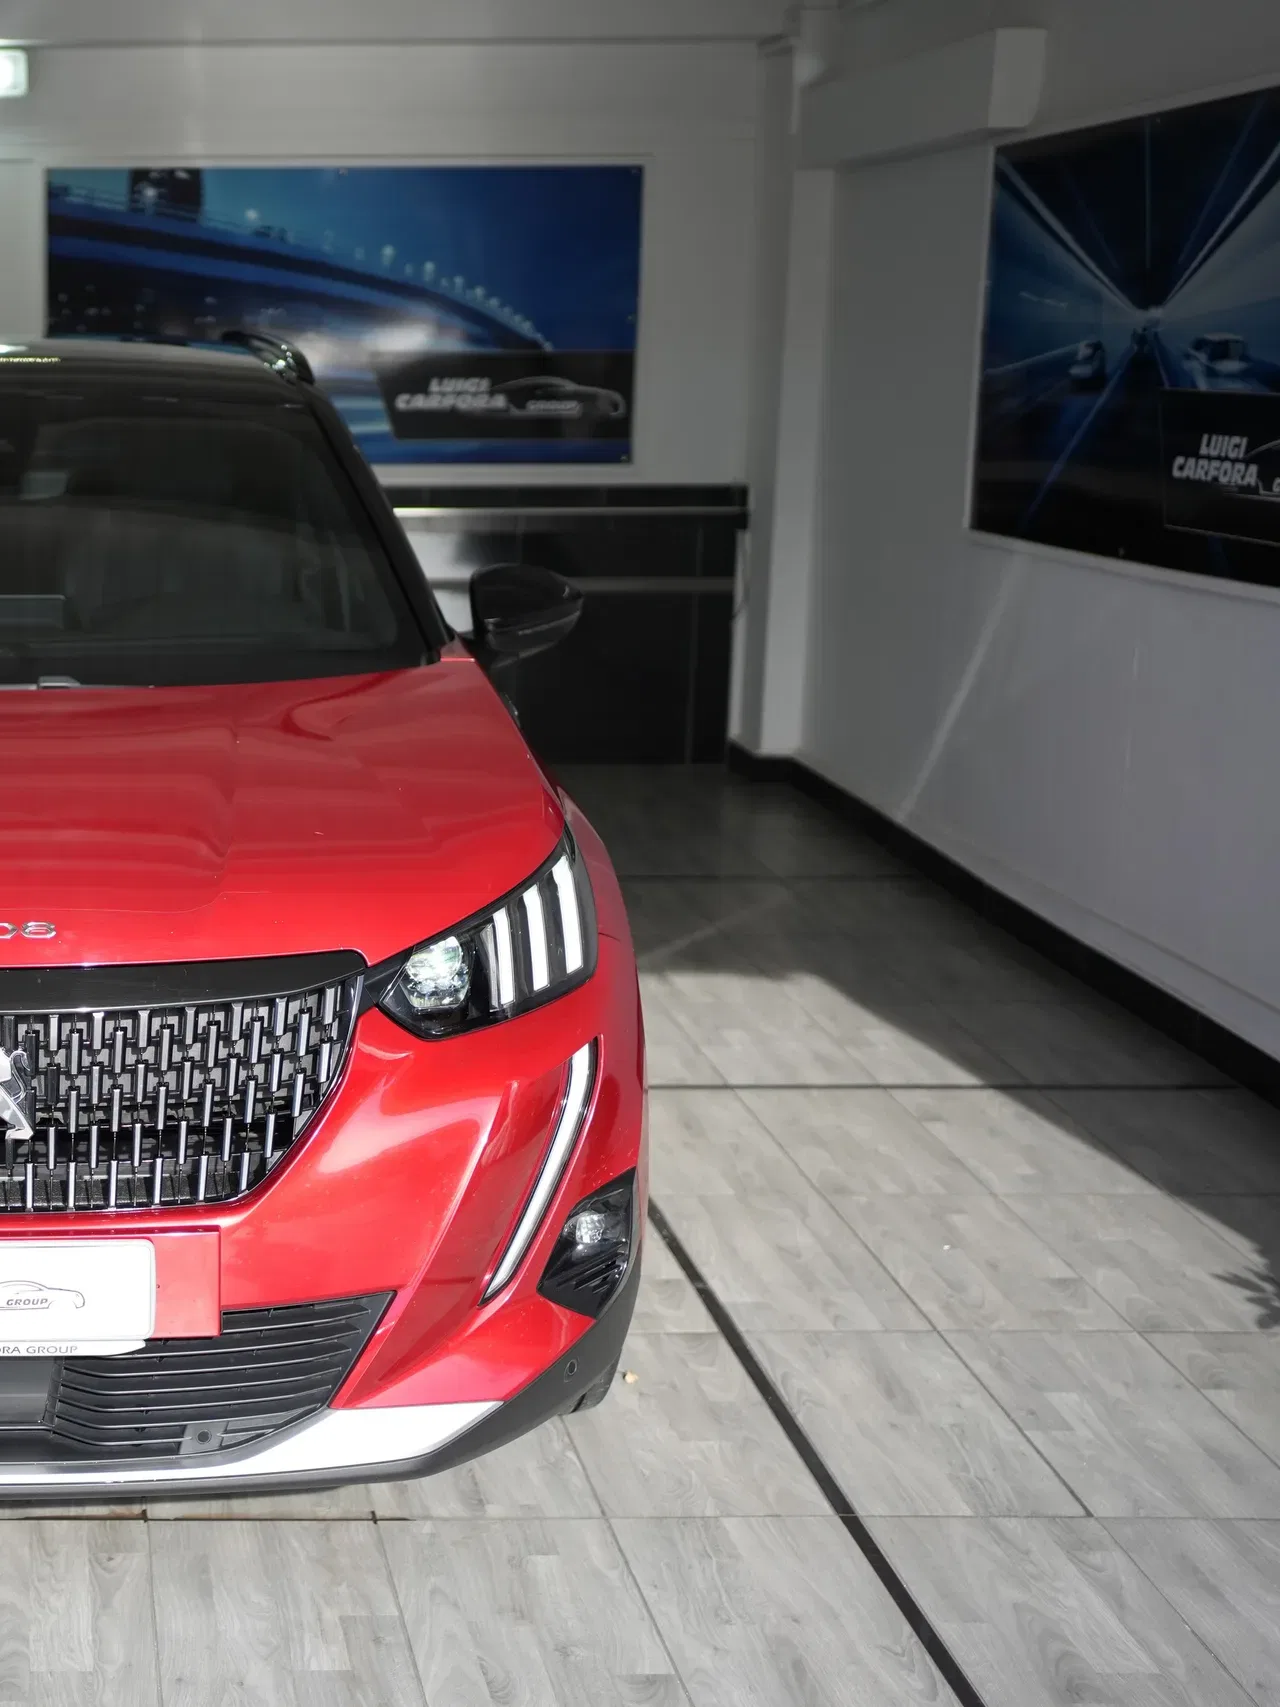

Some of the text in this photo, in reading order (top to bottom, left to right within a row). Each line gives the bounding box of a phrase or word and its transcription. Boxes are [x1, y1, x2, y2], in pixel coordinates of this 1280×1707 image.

[1198, 433, 1249, 459] LUIGI
[1172, 455, 1259, 487] CARFORA
[6, 1298, 48, 1306] GROUP
[25, 1345, 79, 1354] GROUP
